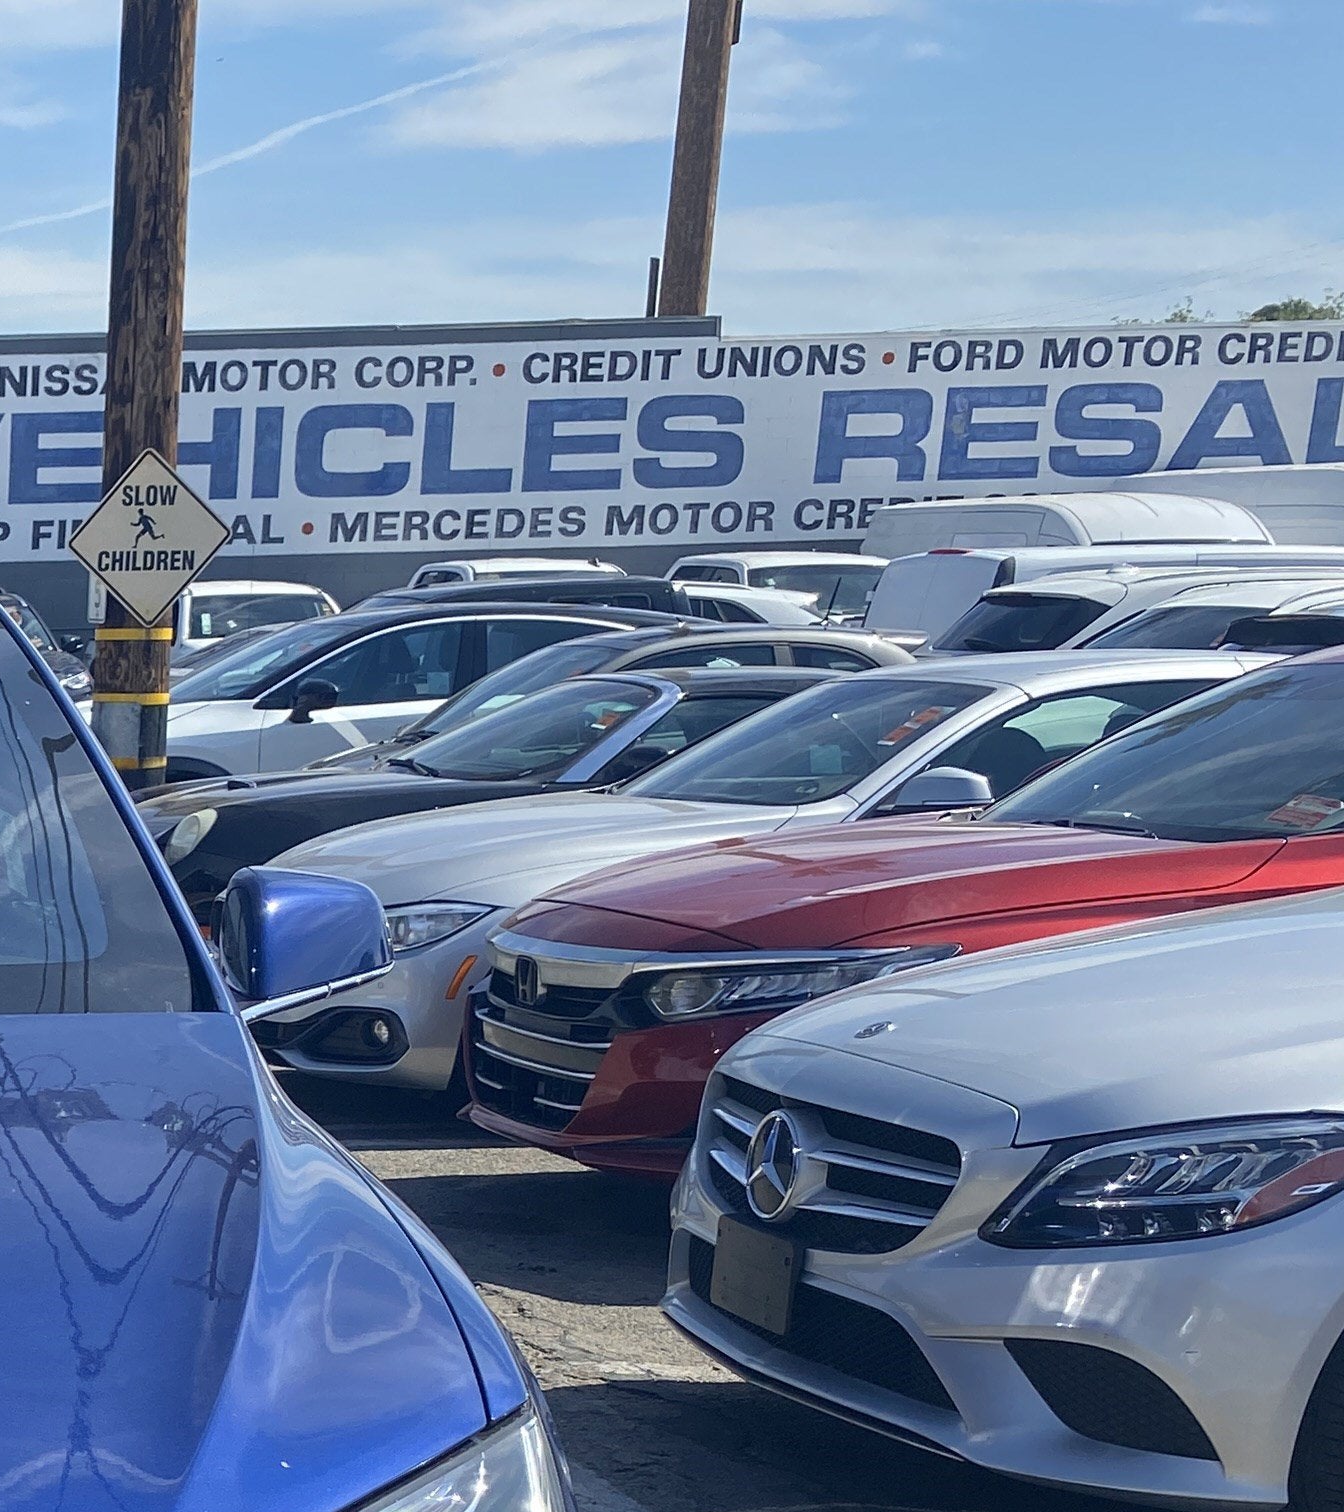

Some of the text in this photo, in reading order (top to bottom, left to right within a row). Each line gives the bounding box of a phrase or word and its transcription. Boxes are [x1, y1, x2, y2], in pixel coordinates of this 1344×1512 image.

[182, 358, 337, 393] MOTOR
[354, 354, 478, 389] CORP.
[522, 348, 682, 384] CREDIT
[696, 343, 866, 379] UNIONS
[907, 339, 1025, 374] FORD
[1040, 334, 1202, 370] MOTOR
[121, 484, 178, 507] SLOW
[328, 505, 587, 544] MERCEDES
[604, 500, 776, 537] MOTOR
[97, 549, 196, 572] CHILDREN
